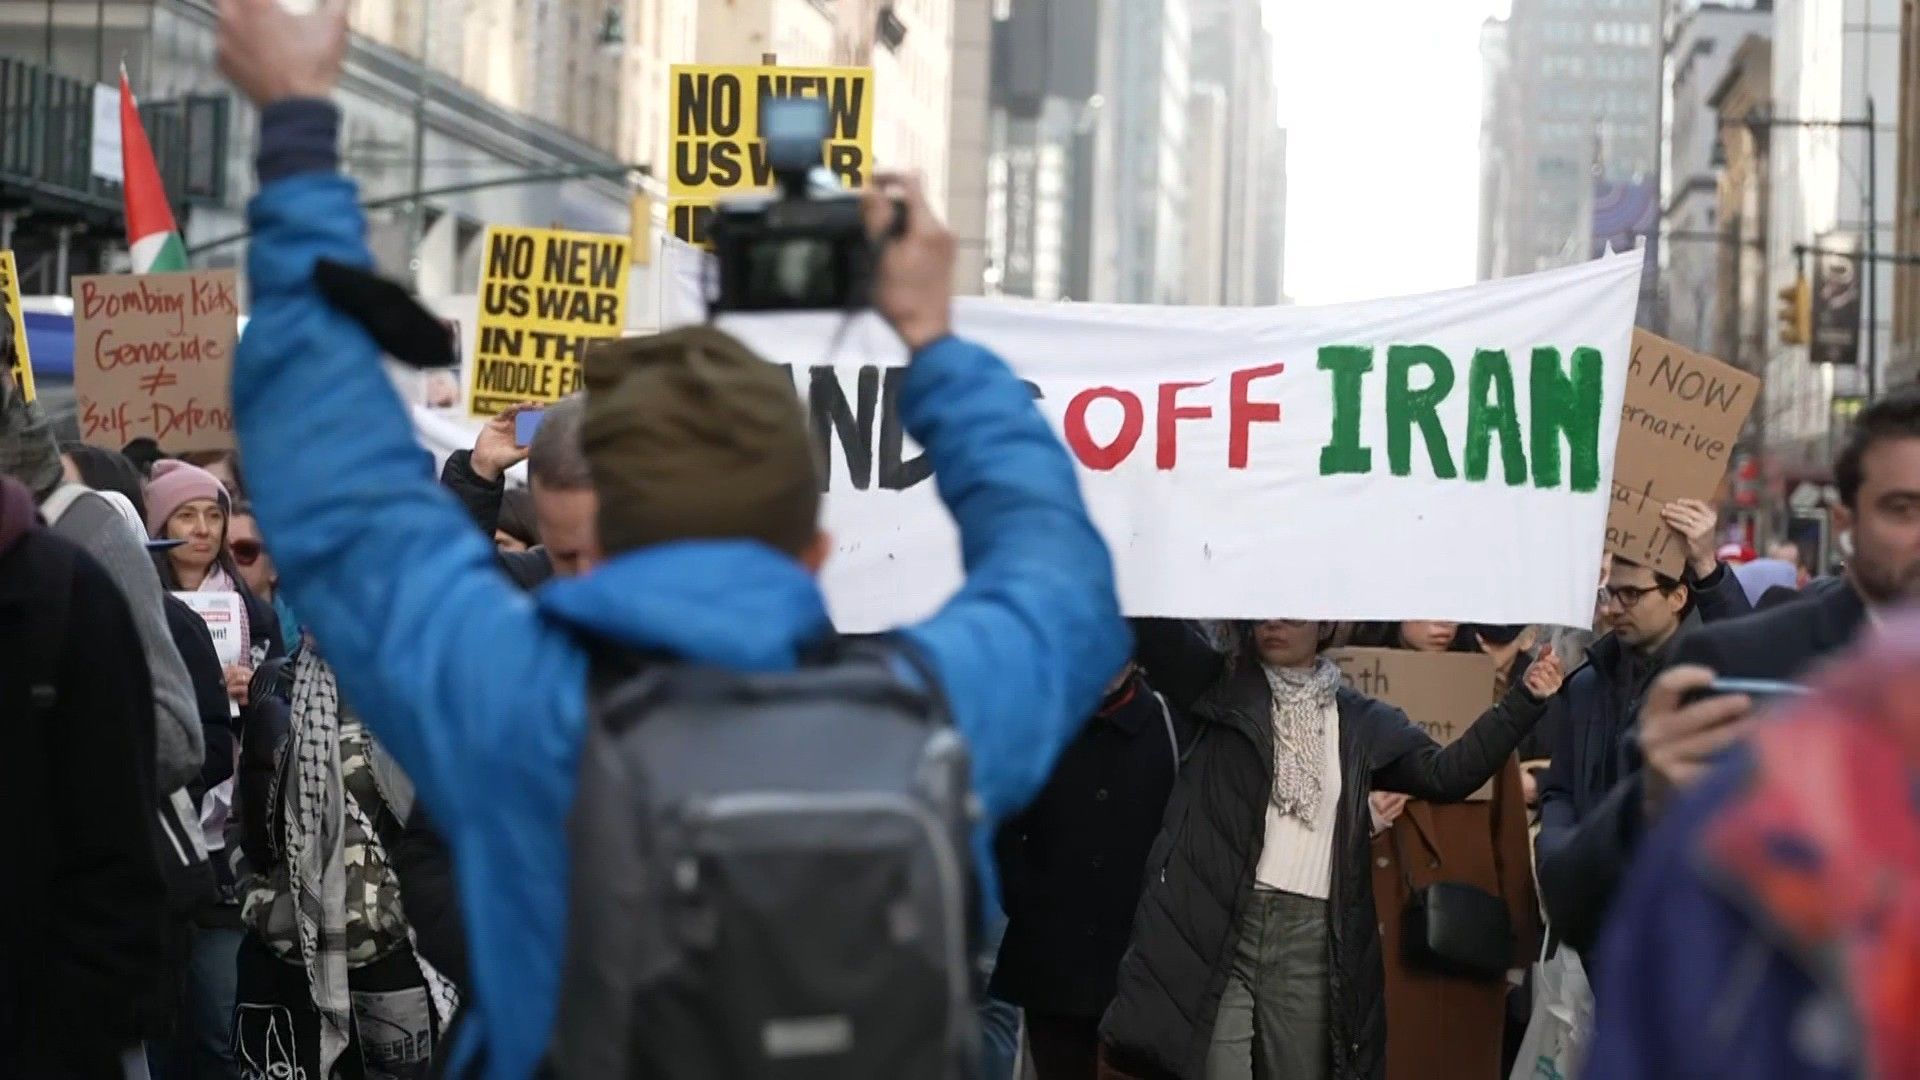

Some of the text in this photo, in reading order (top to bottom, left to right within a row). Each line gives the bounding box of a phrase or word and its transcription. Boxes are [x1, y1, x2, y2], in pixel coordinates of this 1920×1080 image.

[678, 73, 741, 137] NO
[676, 141, 742, 187] US
[489, 234, 624, 288] NO NEW
[82, 280, 185, 337] Bombing
[485, 283, 618, 325] US WAR
[95, 329, 223, 371] Genocide
[480, 327, 614, 361] IN TH
[477, 359, 553, 396] MIDDLE
[1650, 354, 1741, 413] NOW
[1064, 362, 1285, 471] OFF
[1316, 345, 1603, 493] IRAN
